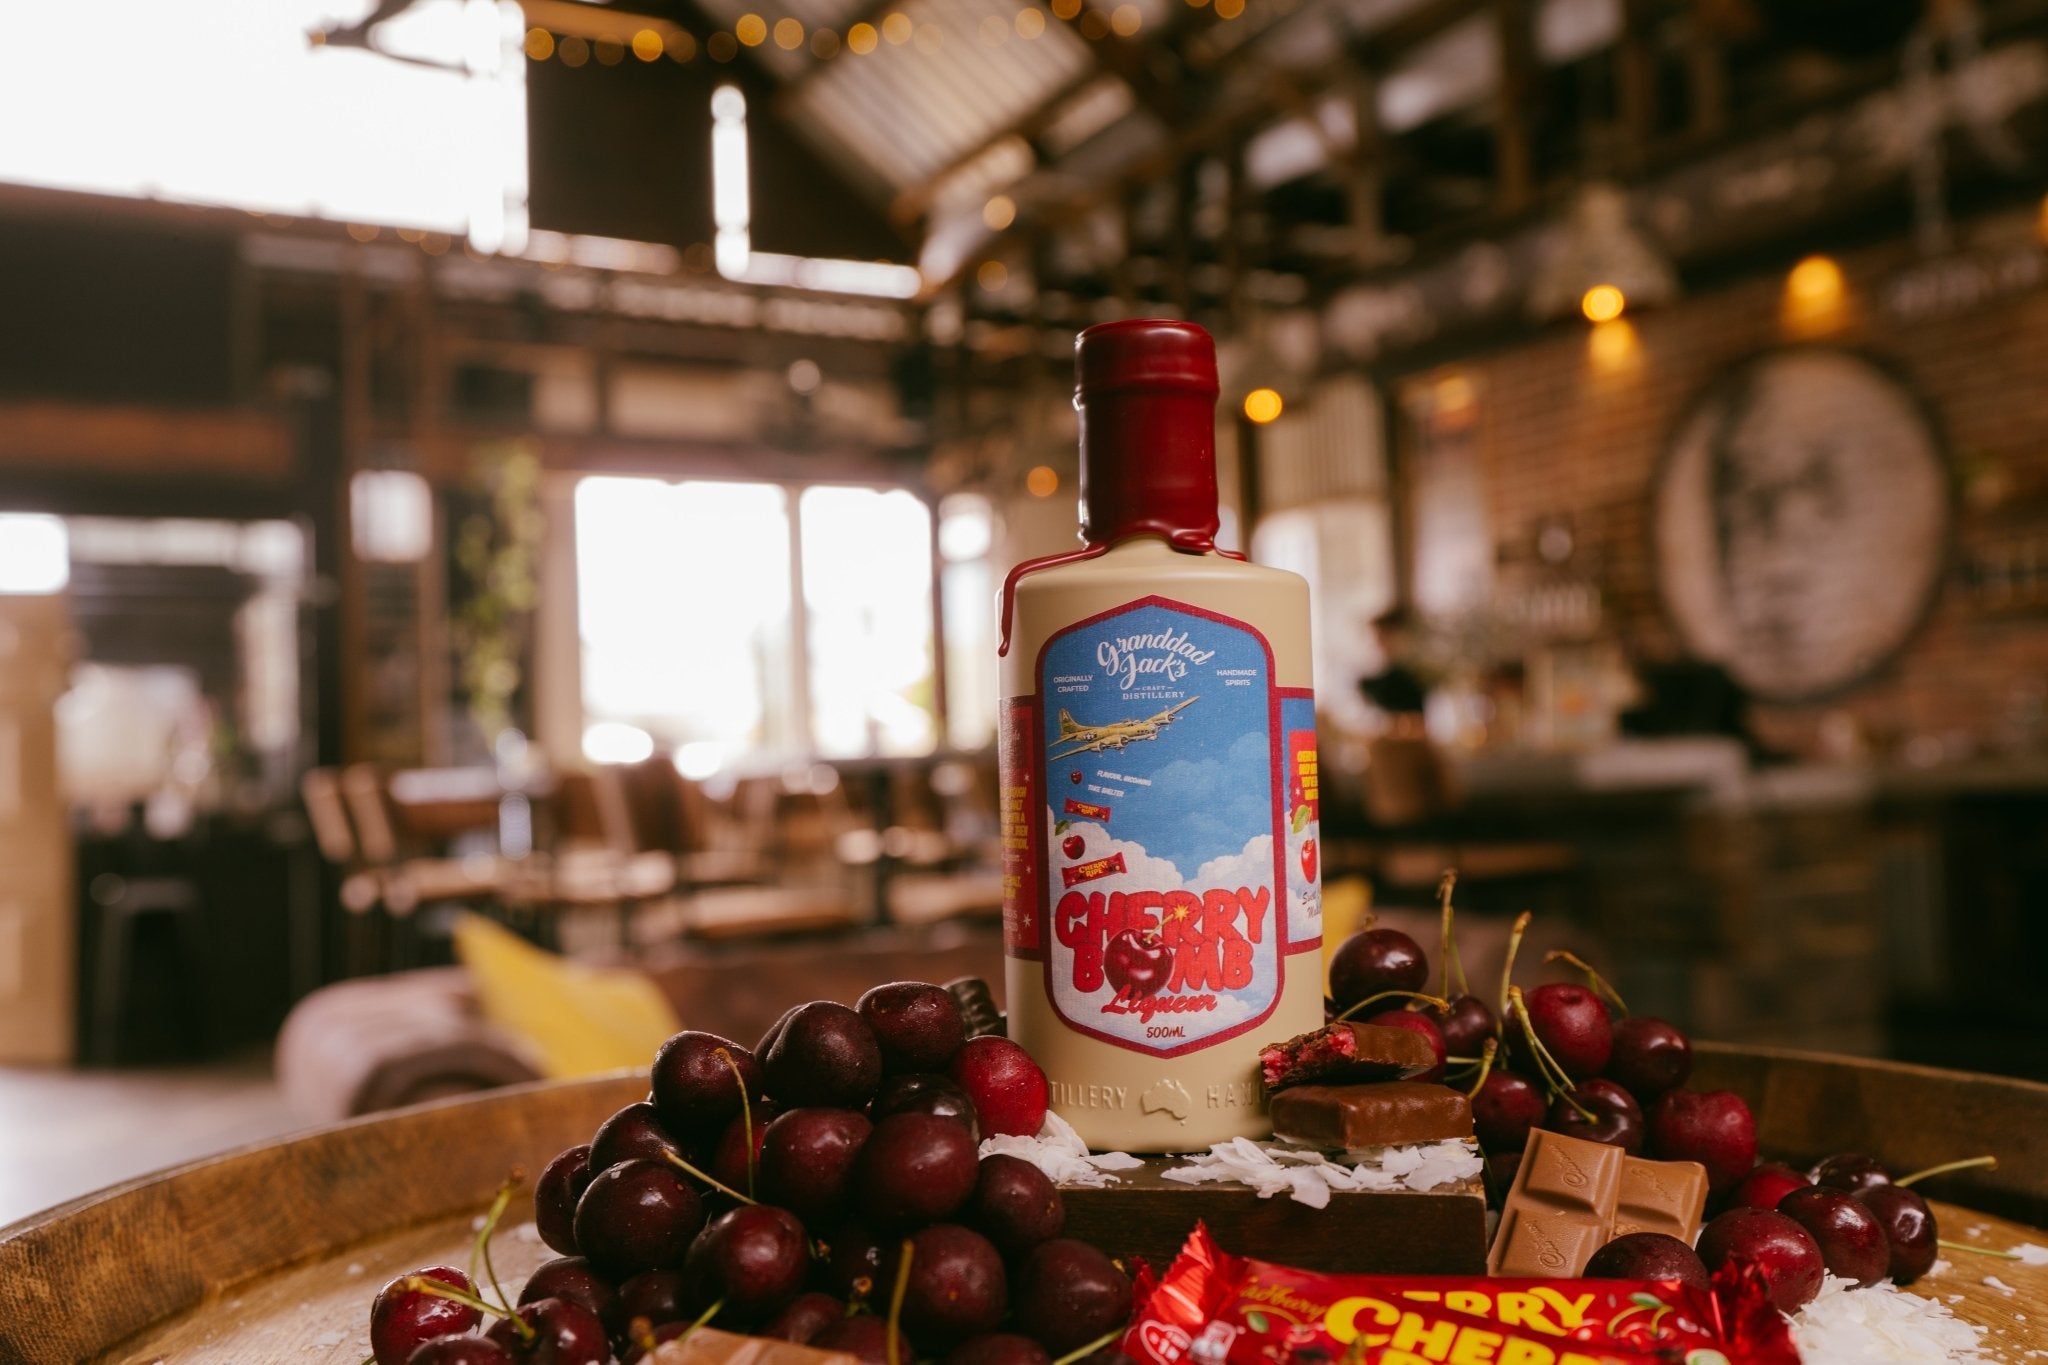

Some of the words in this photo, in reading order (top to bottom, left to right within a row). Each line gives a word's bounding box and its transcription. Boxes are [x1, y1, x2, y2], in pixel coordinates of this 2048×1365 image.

[1097, 627, 1216, 676] Granddad
[1119, 653, 1188, 690] Jack's
[1216, 669, 1257, 677] HANDMADE
[1053, 674, 1094, 683] ORIGINALLY
[1224, 678, 1251, 686] SPIRITS
[1057, 685, 1089, 693] CRAFTED
[1122, 691, 1185, 700] DISTILLERY
[1079, 860, 1108, 874] CHERRY
[1086, 868, 1102, 878] RIPE
[1054, 885, 1271, 949] CHERRY
[1101, 984, 1217, 1024] Liqueur
[1206, 1082, 1260, 1109] HAN
